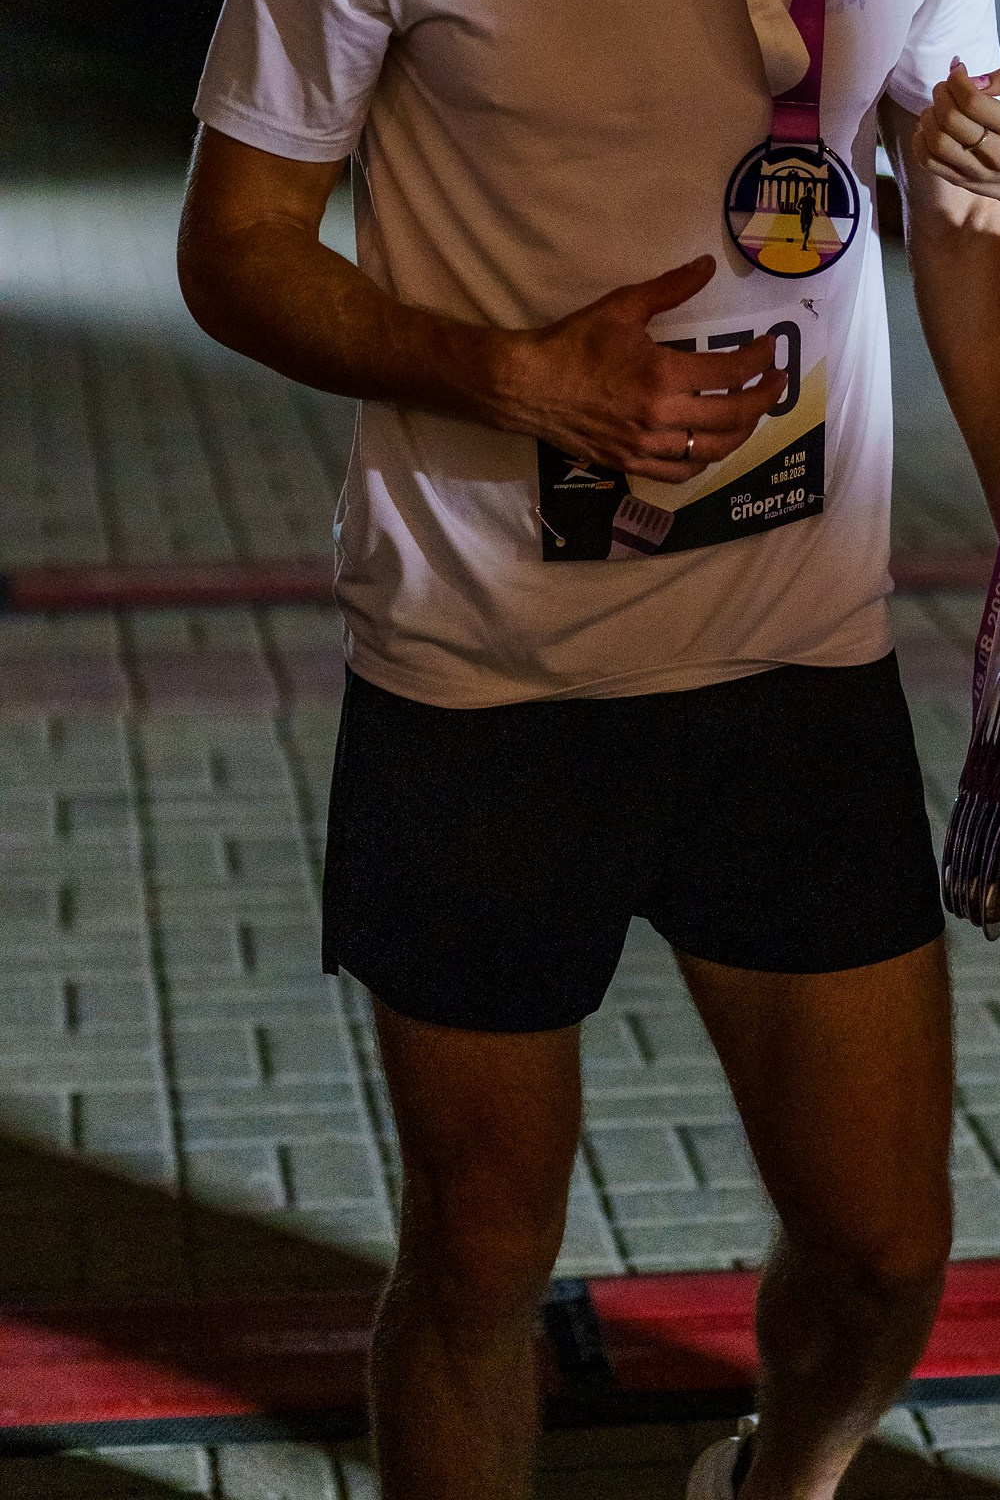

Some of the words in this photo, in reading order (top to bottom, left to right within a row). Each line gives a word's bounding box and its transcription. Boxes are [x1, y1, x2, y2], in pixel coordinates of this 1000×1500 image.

[730, 493, 752, 506] PRO
[731, 493, 784, 521] СПОРТ
[786, 487, 805, 504] 40
